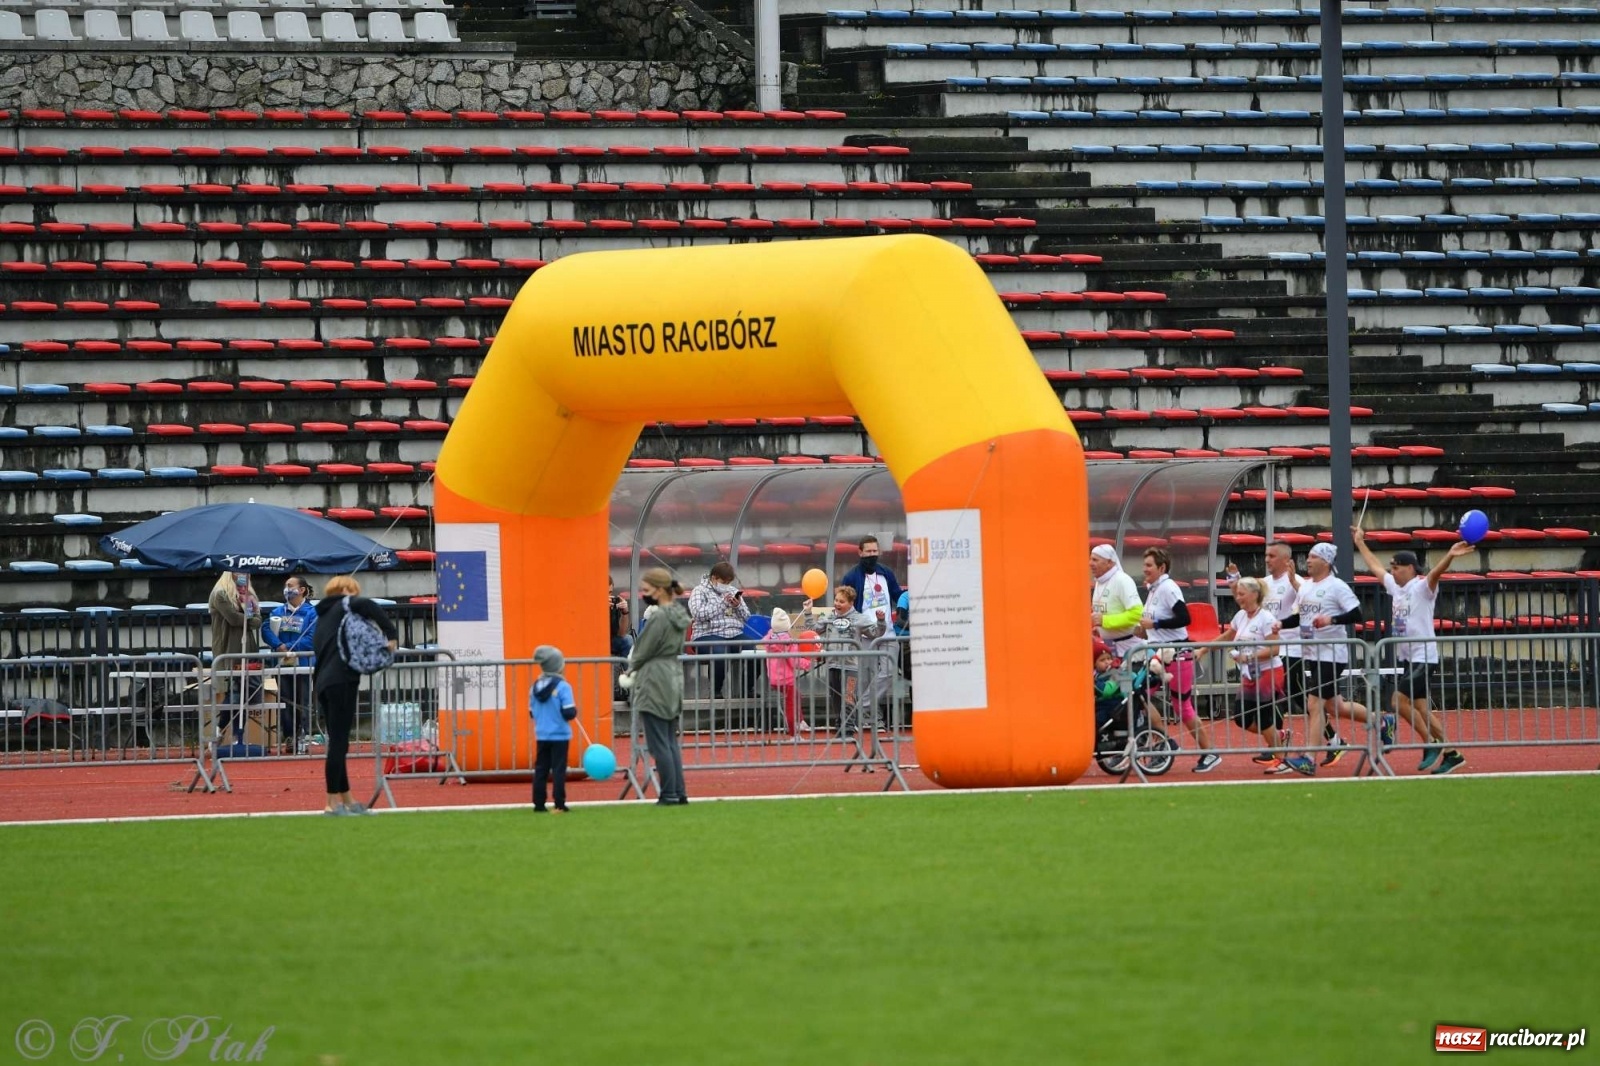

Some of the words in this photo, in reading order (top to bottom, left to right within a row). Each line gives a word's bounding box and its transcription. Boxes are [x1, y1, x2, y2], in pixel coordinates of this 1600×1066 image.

[573, 322, 656, 357] MIASTO
[662, 310, 778, 354] RACIBÓRZ
[238, 555, 287, 568] polanik
